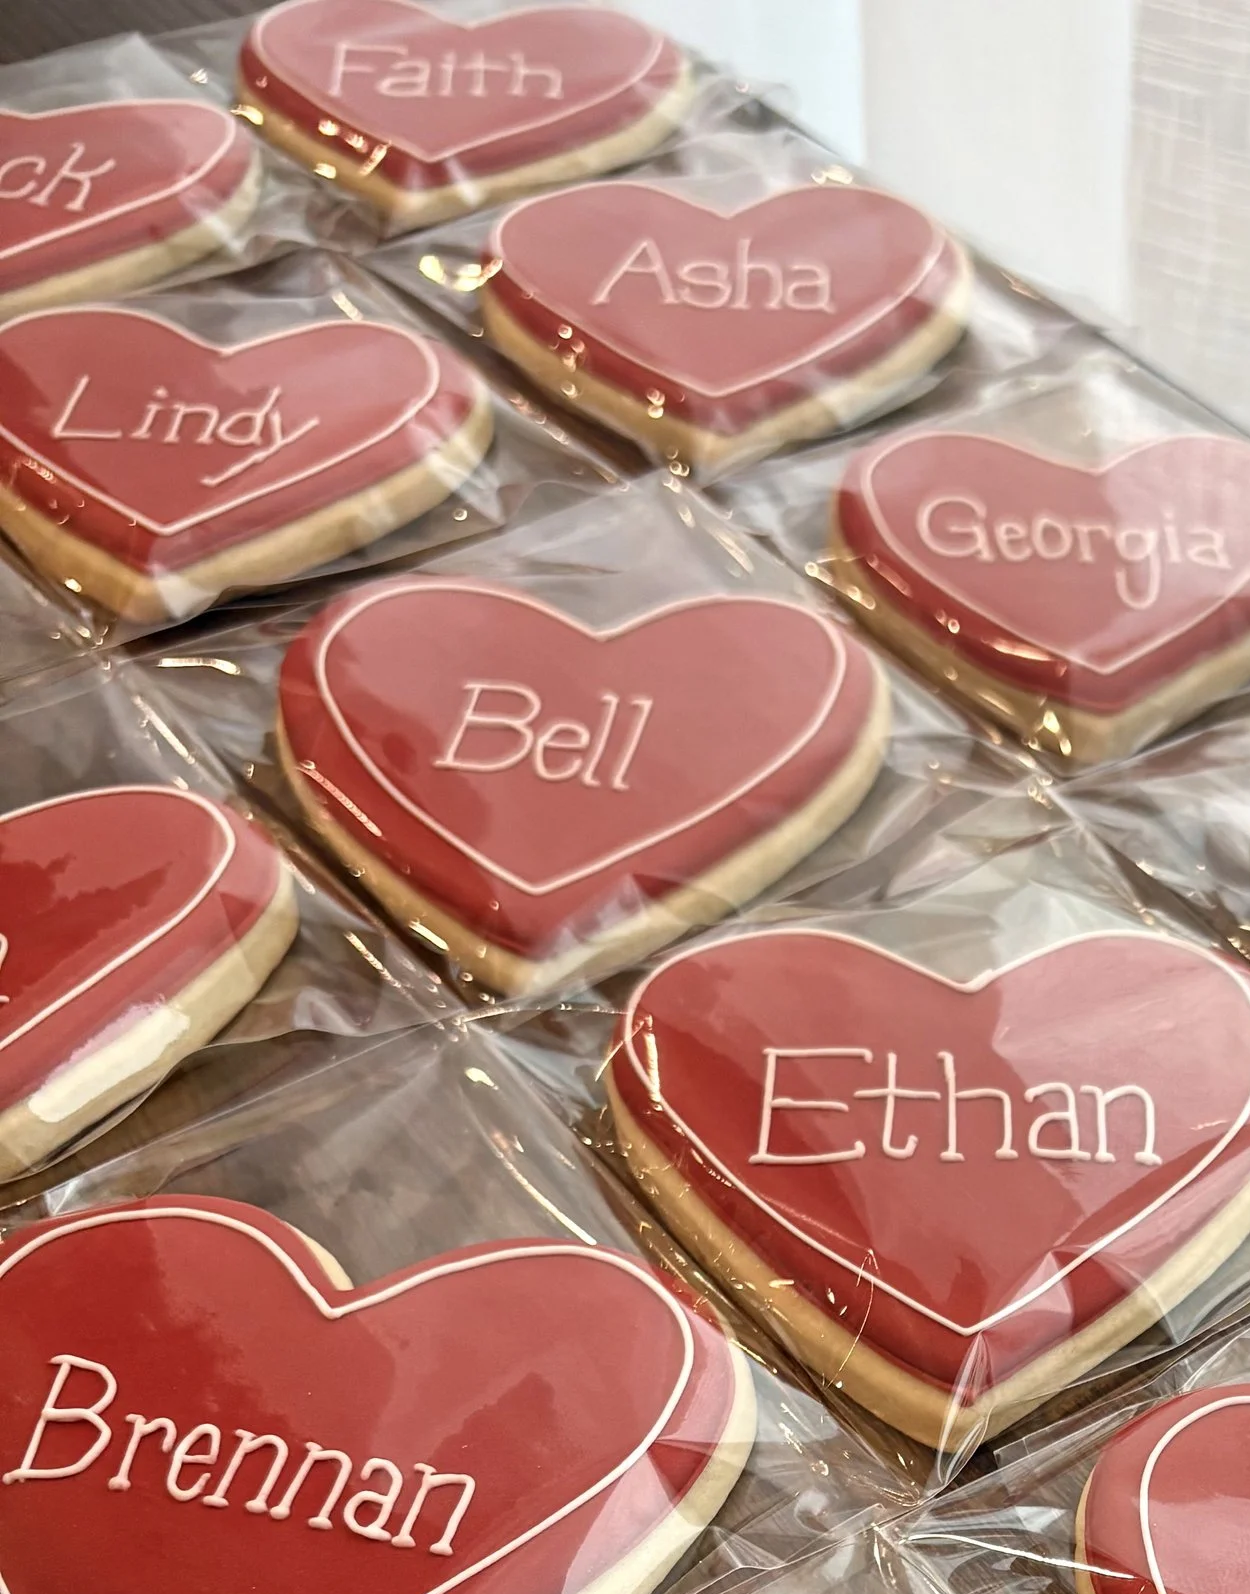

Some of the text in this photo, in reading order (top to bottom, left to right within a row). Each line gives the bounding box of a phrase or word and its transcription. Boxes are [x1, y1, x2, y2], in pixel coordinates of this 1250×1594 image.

[328, 41, 564, 100] Faith
[591, 239, 838, 313] Asha
[50, 375, 320, 486] Lindy
[916, 497, 1232, 610] Georgia
[434, 682, 652, 791] Bell
[748, 1046, 1163, 1165] Ethan
[3, 1354, 476, 1556] Brennan
